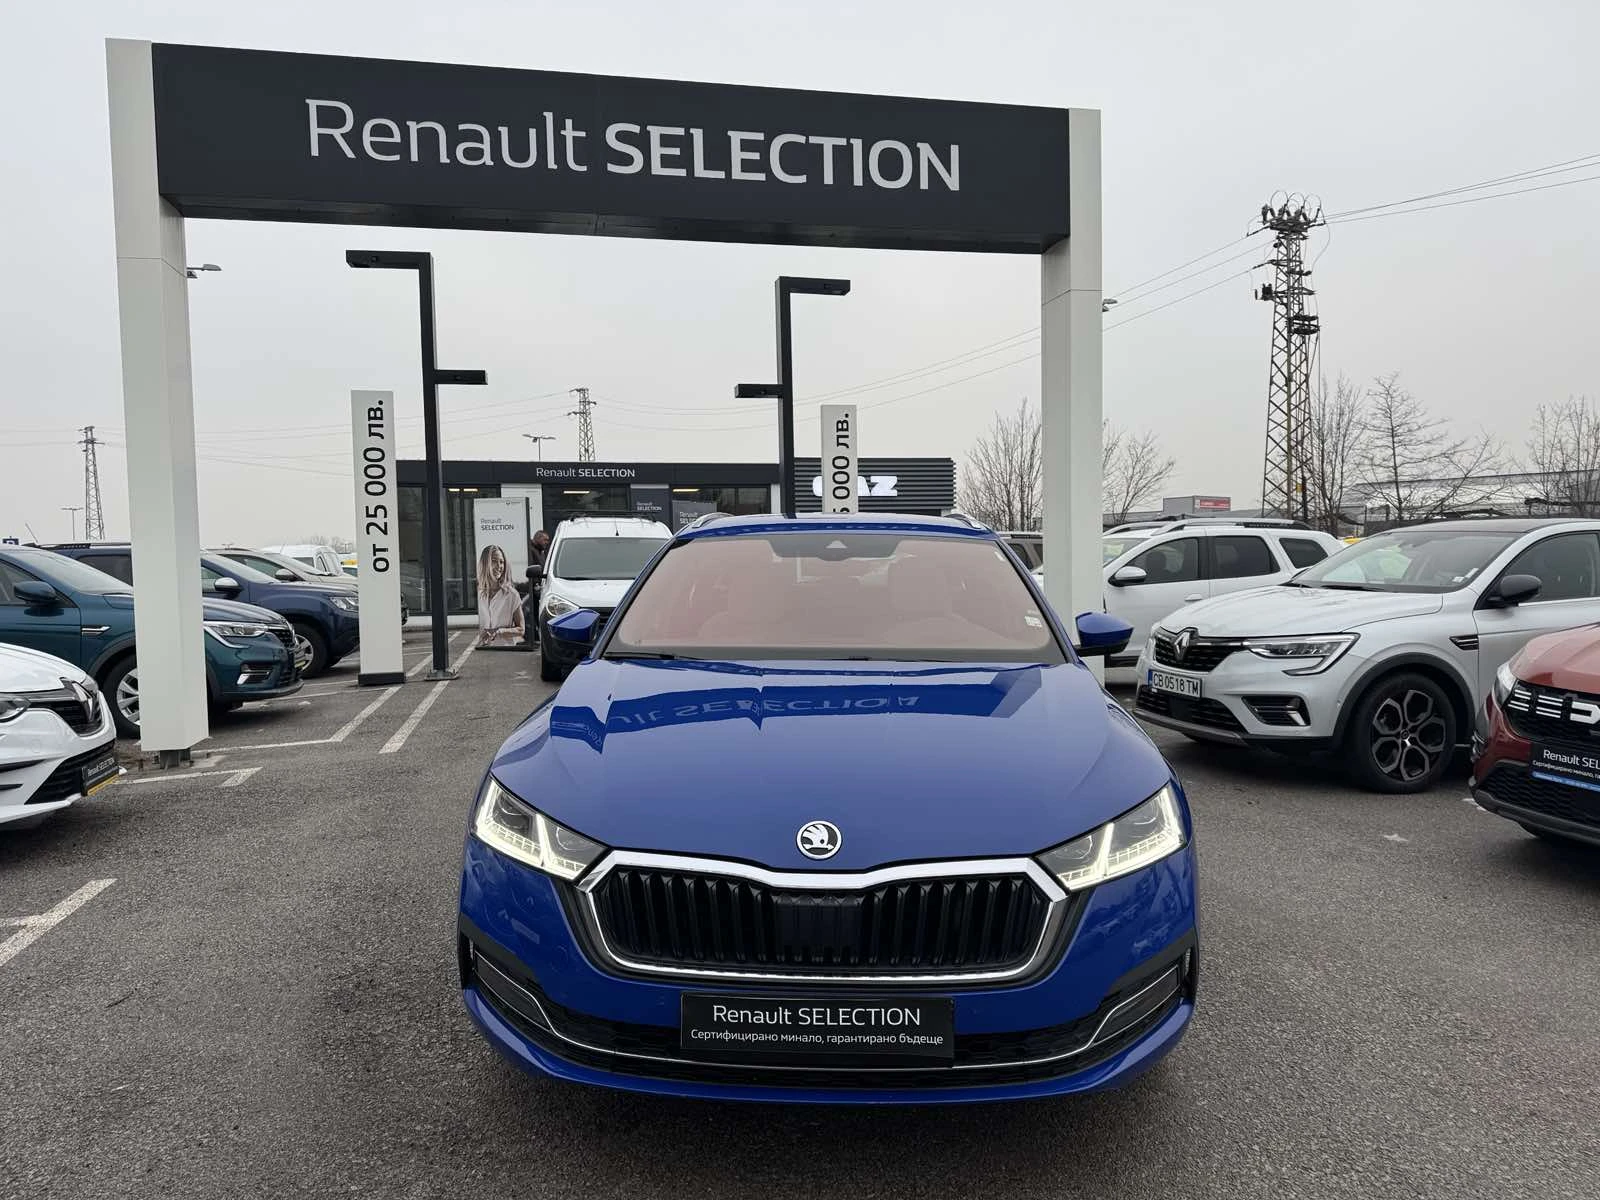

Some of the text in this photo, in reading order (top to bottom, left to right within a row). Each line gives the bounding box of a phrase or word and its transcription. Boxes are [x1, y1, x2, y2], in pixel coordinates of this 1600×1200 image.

[305, 98, 961, 191] Renault SELECTION
[363, 447, 387, 497] 000
[536, 467, 635, 478] Renault SELECTION
[832, 455, 850, 500] 000
[365, 504, 389, 536] 25
[1543, 749, 1580, 766] Renault
[713, 1004, 921, 1026] Renault SELECTION
[690, 1028, 944, 1046] Сертифицирано минало, гарантирано бъдеще
